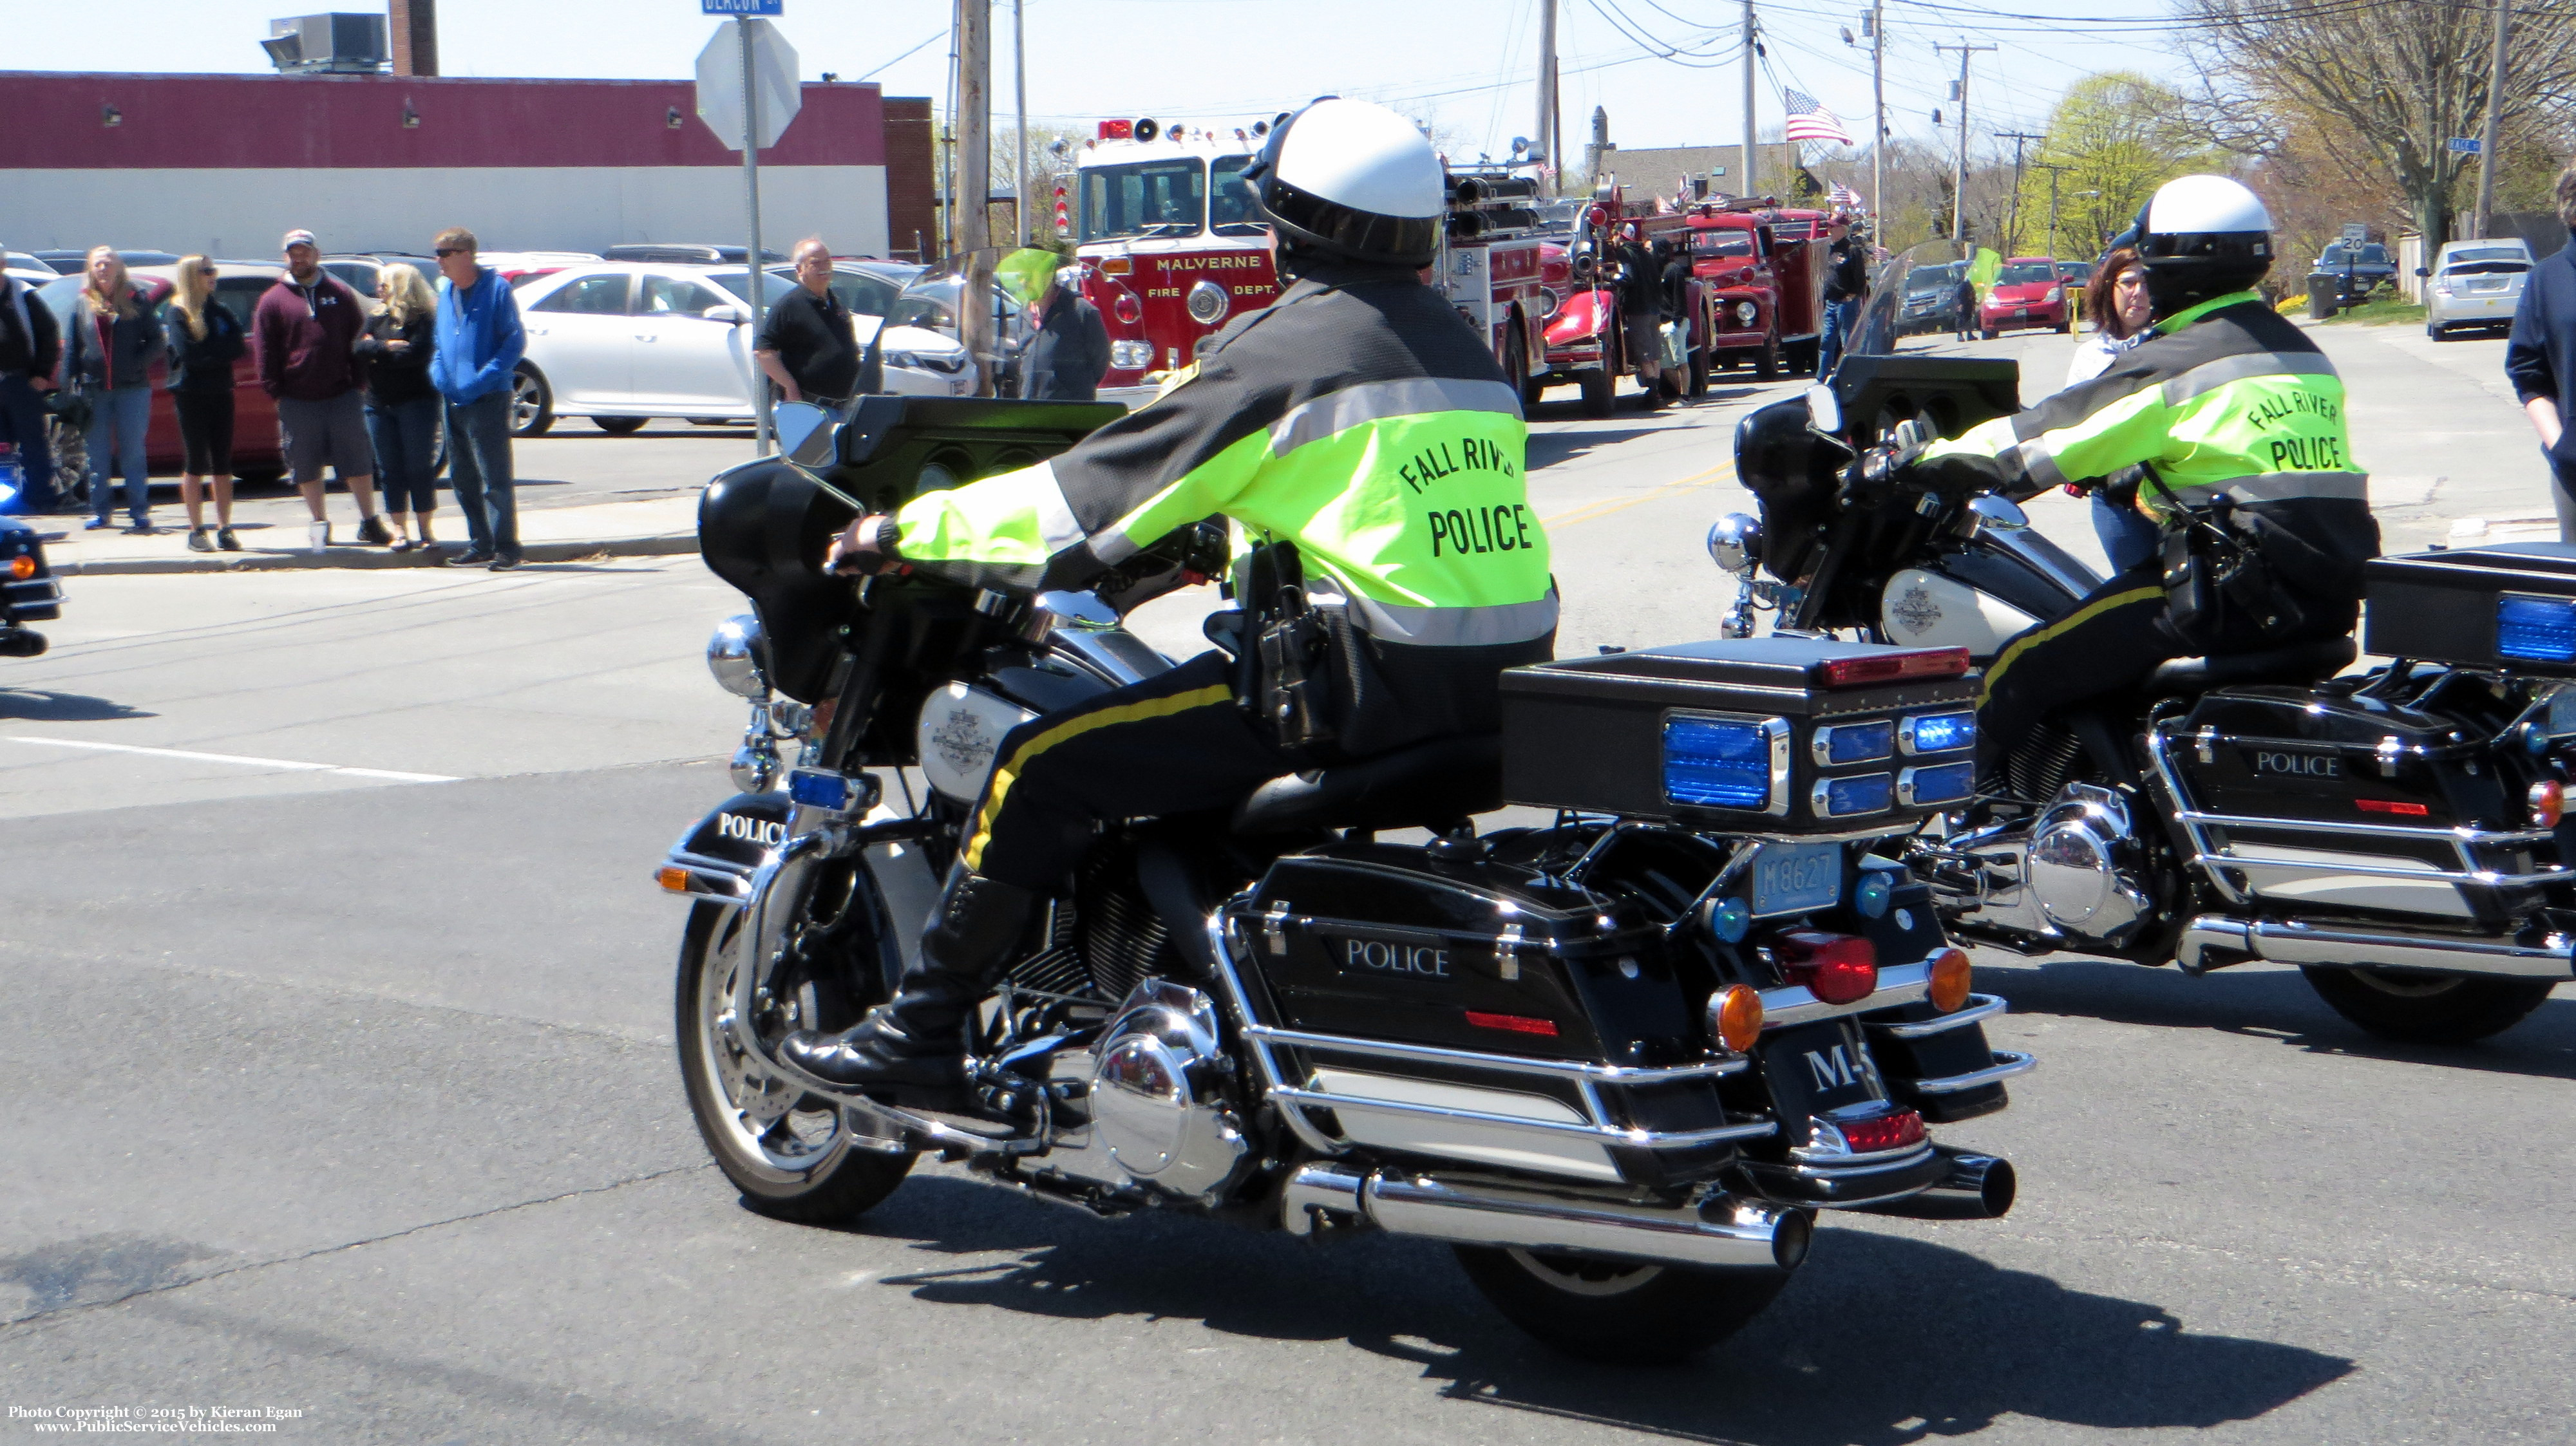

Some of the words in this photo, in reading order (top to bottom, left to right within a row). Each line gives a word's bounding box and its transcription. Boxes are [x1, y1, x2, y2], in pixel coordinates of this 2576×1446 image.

[2344, 238, 2362, 250] 20
[1157, 256, 1261, 271] MALVERNE
[1148, 288, 1180, 298] FIRE
[1234, 285, 1275, 295] DEPT.
[2248, 394, 2293, 431] FALL
[2292, 391, 2336, 426] RIVER
[1399, 442, 1460, 495] FALL
[2270, 437, 2342, 471] POLICE
[1428, 504, 1533, 558] POLICE
[2258, 751, 2338, 776] POLICE
[1764, 852, 1831, 897] M8627
[1347, 939, 1450, 976] POLICE
